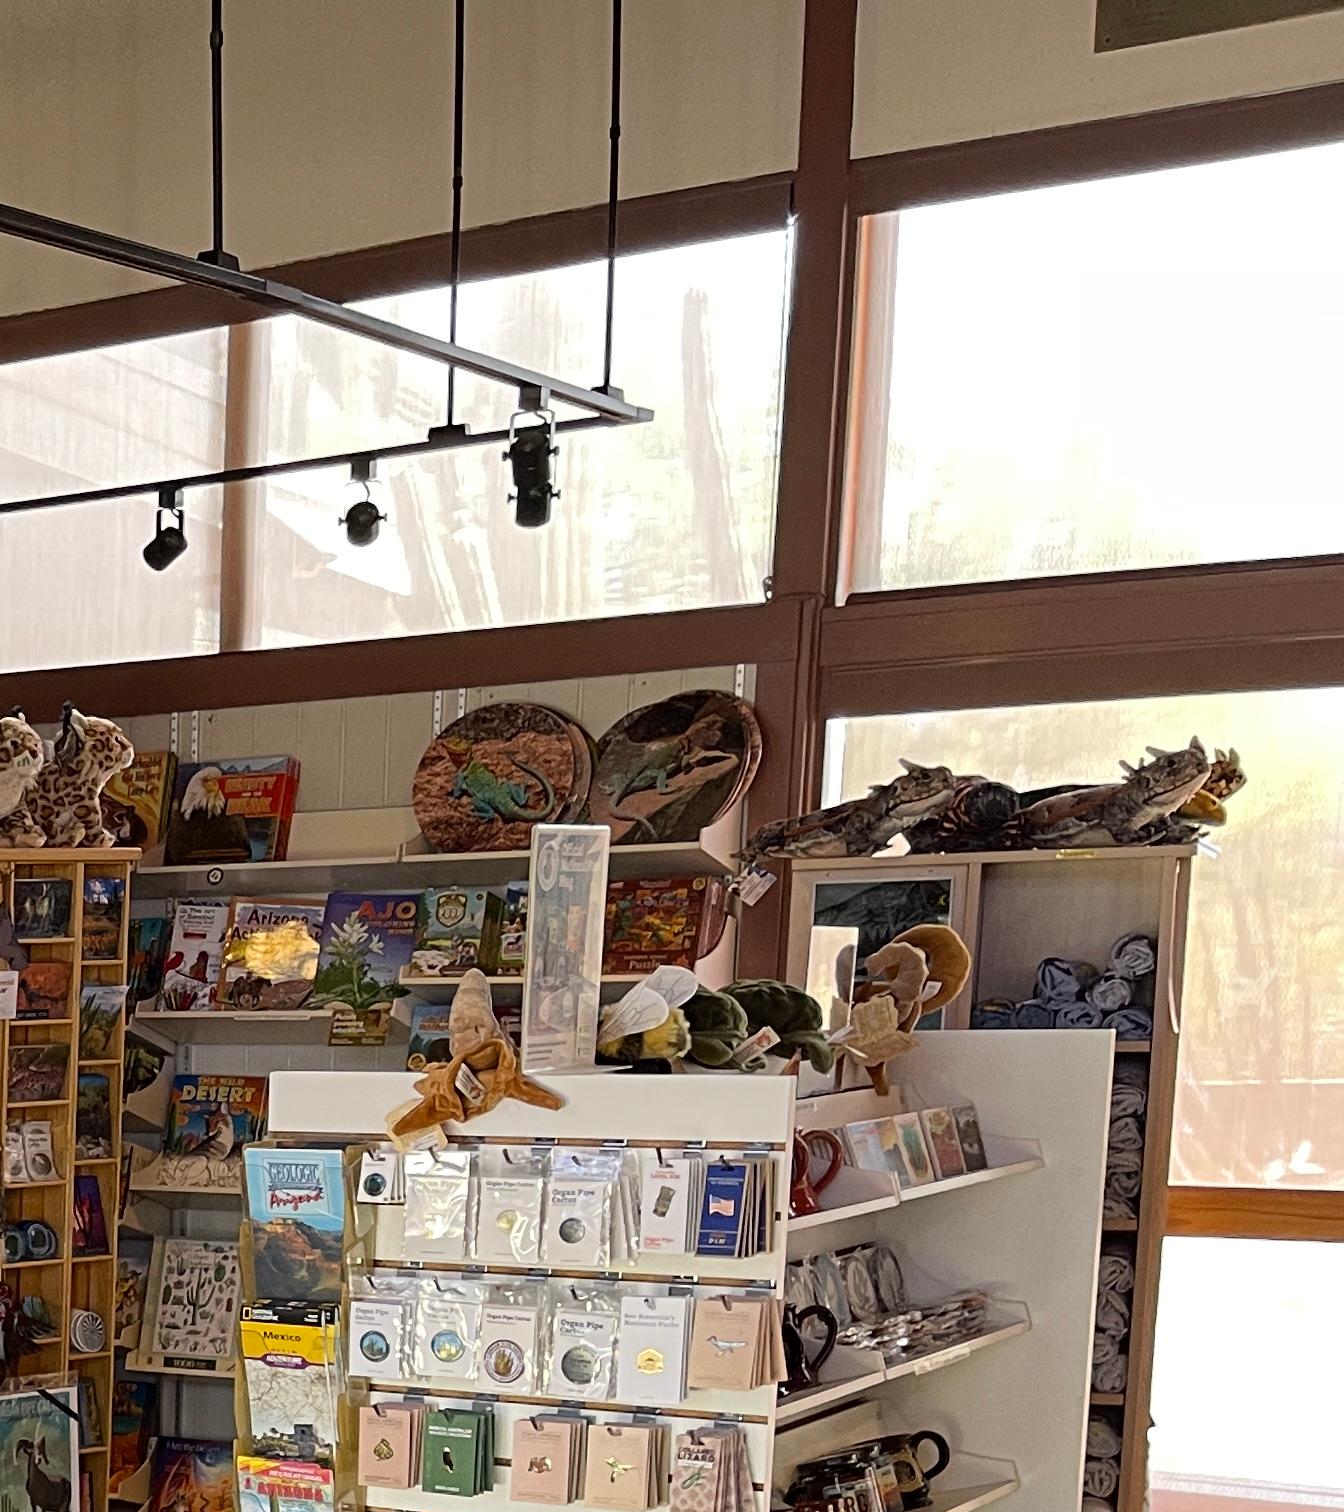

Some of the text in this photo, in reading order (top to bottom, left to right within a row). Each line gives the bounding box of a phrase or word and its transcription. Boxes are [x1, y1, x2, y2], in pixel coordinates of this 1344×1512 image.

[358, 901, 417, 920] AJO
[182, 1085, 256, 1103] DESERT
[552, 1189, 576, 1197] Organ
[560, 1319, 604, 1330] Organ Pipe
[263, 1331, 302, 1343] Mexico
[678, 1452, 715, 1462] LIZARD
[257, 1482, 325, 1502] ARIZONA
